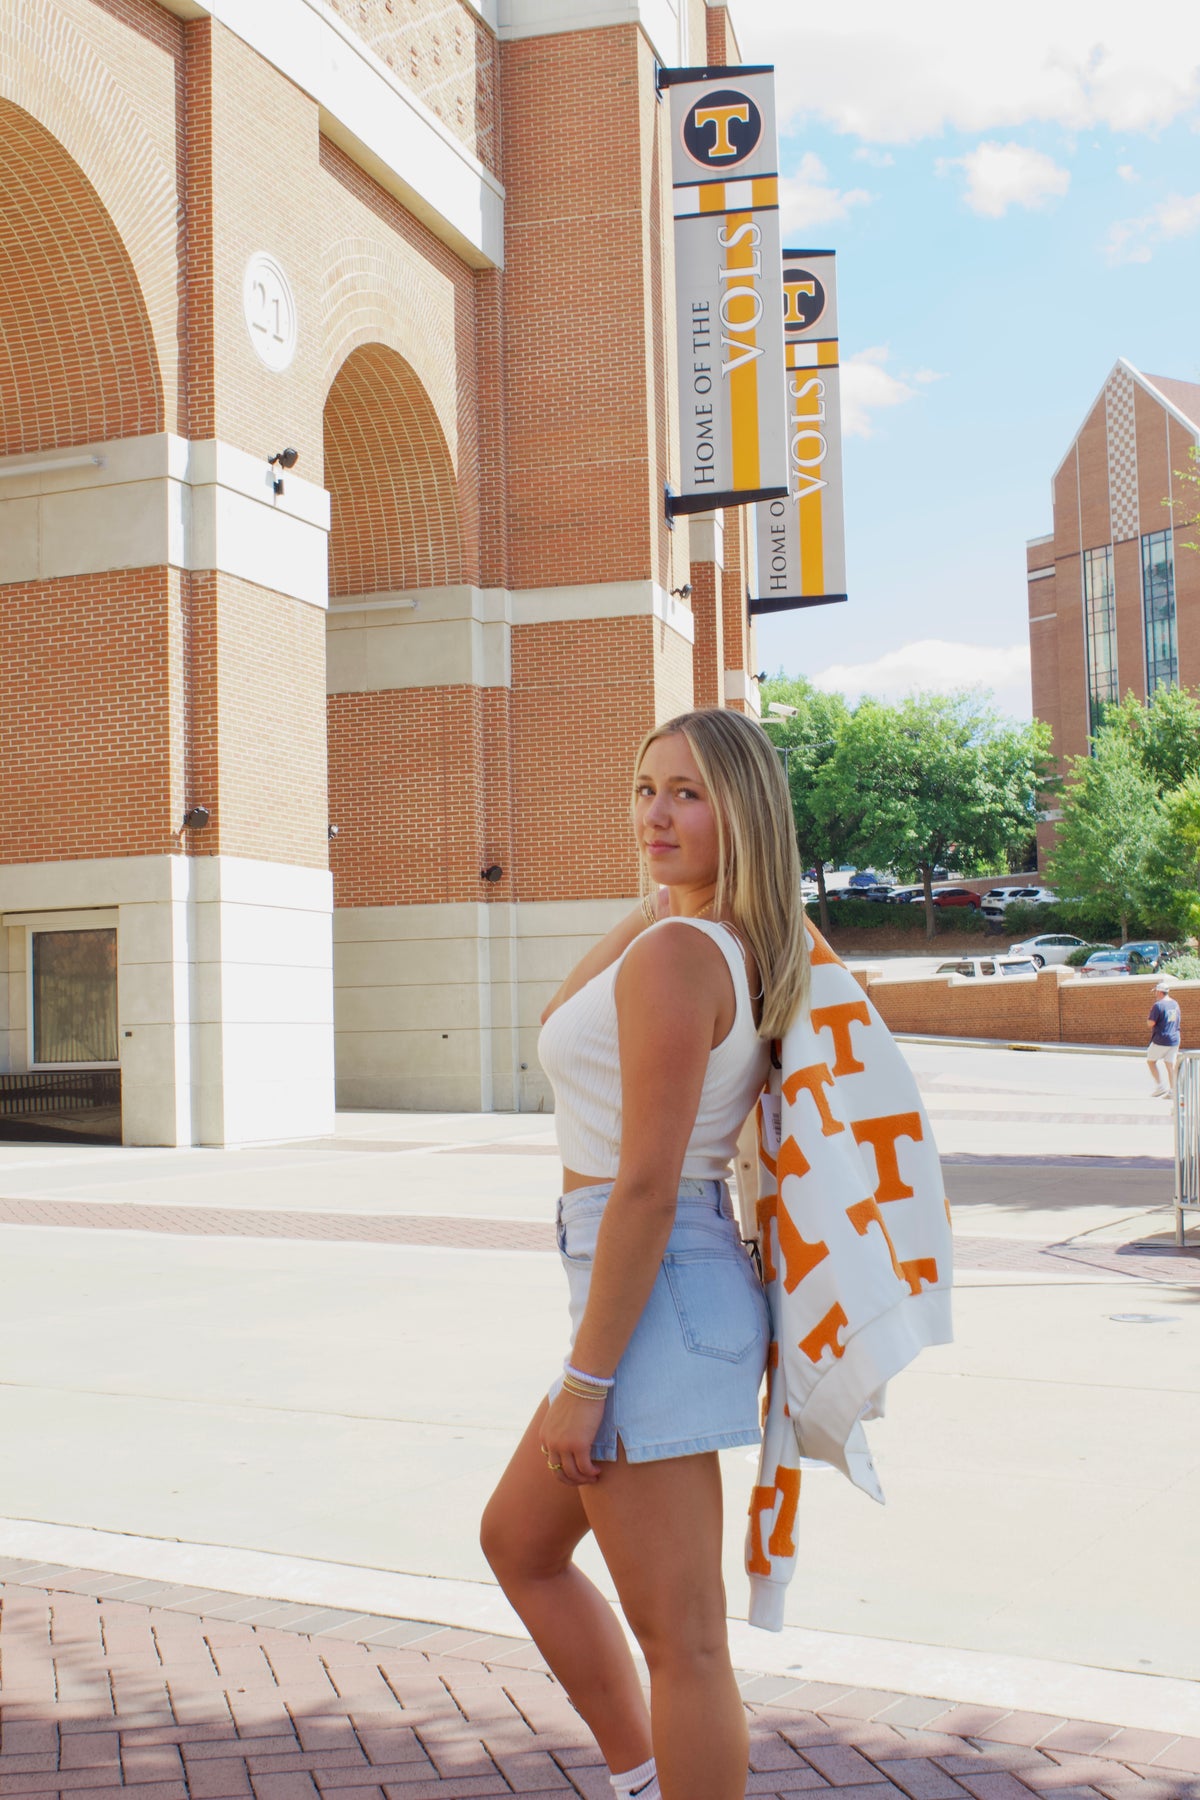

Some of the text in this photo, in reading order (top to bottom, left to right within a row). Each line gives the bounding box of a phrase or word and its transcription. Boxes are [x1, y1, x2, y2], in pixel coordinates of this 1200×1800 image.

[694, 102, 750, 157] T
[251, 279, 285, 345] 21
[716, 221, 765, 379] VOLS
[691, 300, 715, 486] HOME OF THE
[788, 376, 829, 505] VOLS
[769, 495, 788, 591] HOME O
[810, 1000, 871, 1077] T
[781, 1062, 845, 1137] T
[850, 1111, 923, 1204] T
